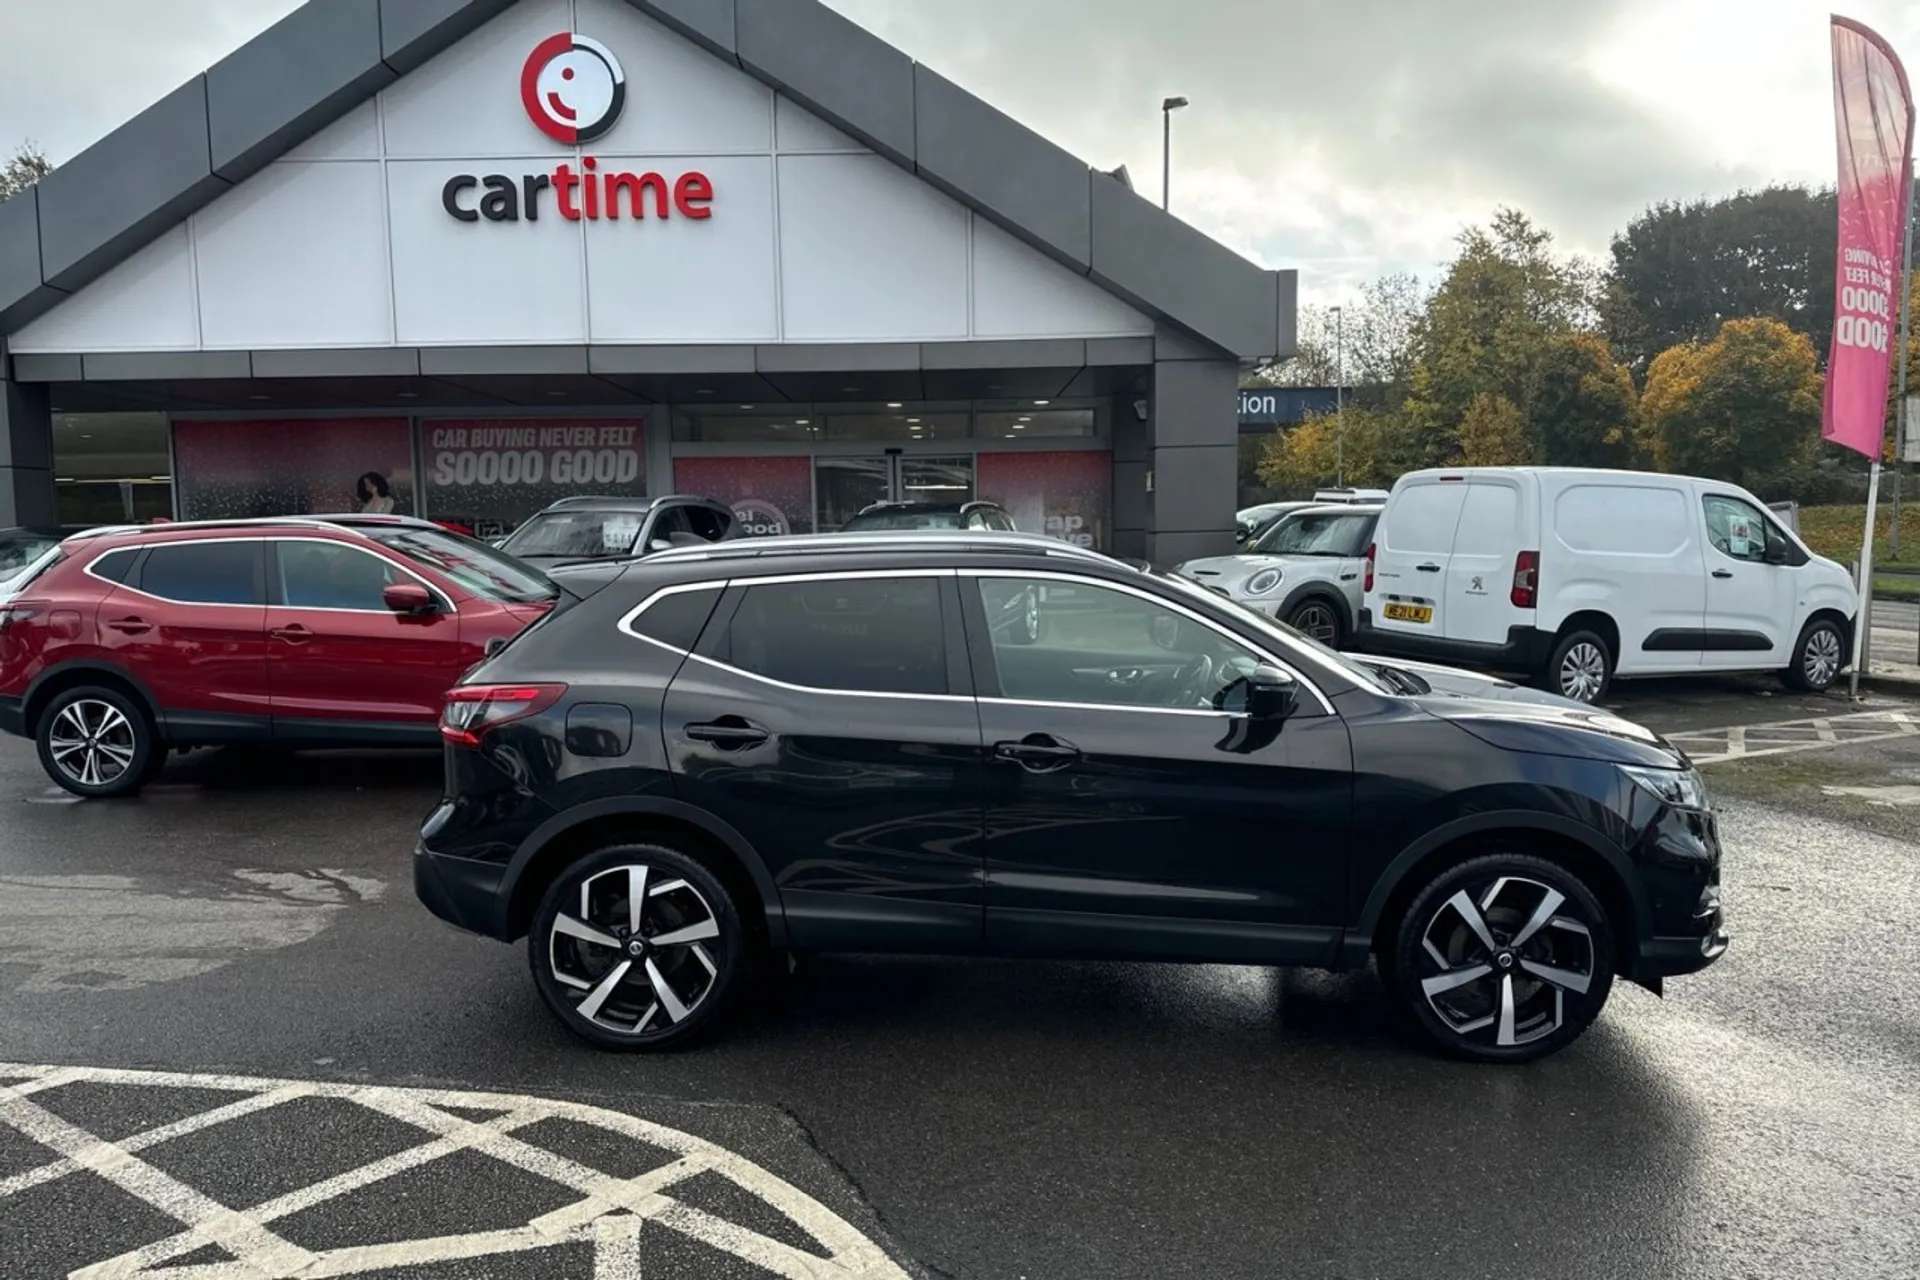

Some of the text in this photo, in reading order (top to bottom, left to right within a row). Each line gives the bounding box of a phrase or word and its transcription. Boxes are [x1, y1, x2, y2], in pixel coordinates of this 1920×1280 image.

[442, 156, 713, 222] cartime
[1237, 392, 1276, 414] ion
[432, 426, 636, 448] CAR BUYING NEVER FELT
[433, 449, 638, 486] SOOOO GOOD
[735, 510, 753, 521] el
[1046, 516, 1084, 534] ap
[743, 522, 781, 534] ood
